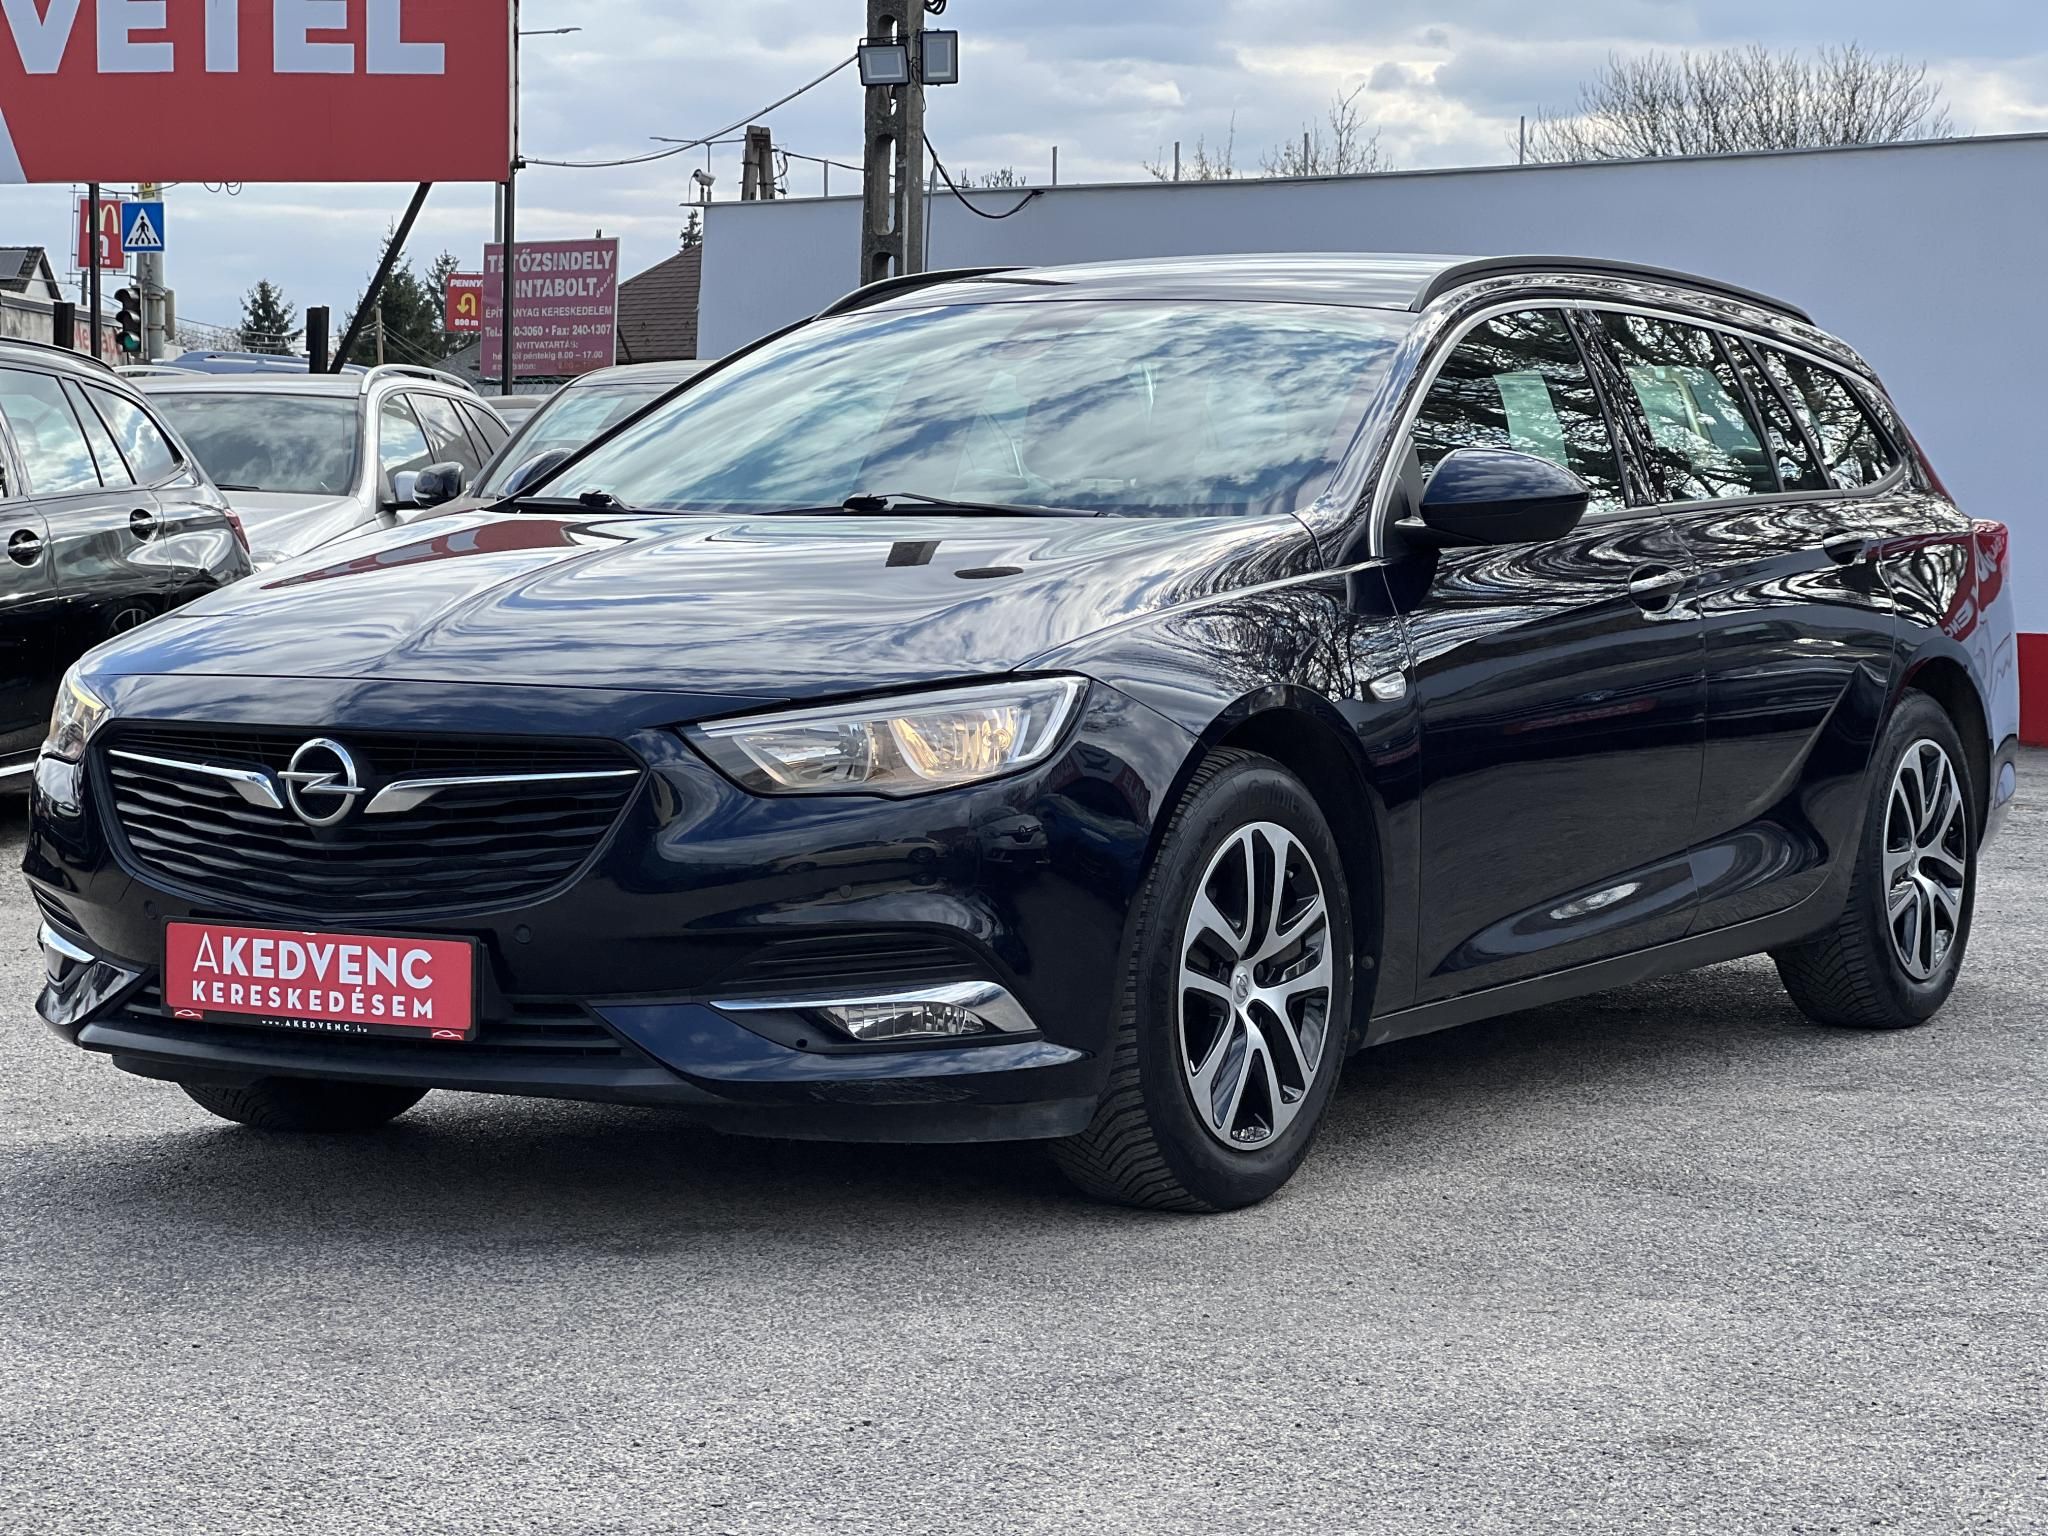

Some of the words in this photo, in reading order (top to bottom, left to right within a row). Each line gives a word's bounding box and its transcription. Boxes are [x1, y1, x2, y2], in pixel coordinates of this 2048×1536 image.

[502, 278, 598, 298] INTABOLT
[541, 306, 612, 317] KERESKEDELEM
[551, 324, 570, 336] Fax:
[572, 324, 611, 335] 240-1307
[192, 980, 434, 1020] KERESKEDÉSEM
